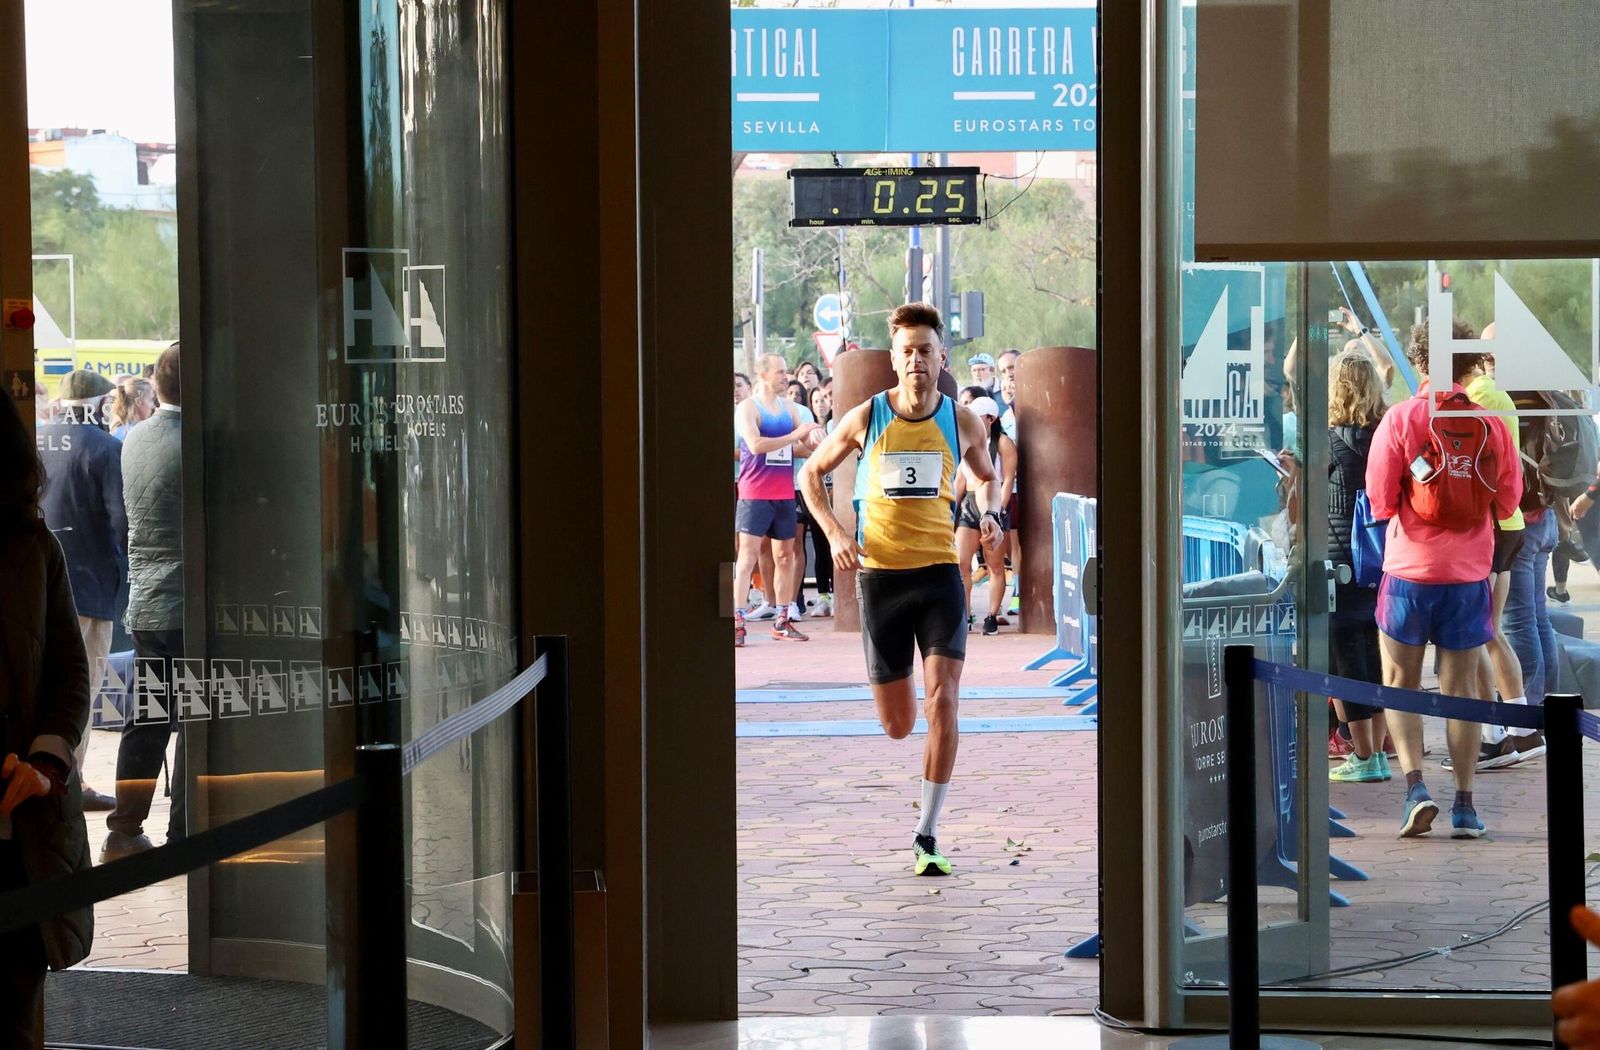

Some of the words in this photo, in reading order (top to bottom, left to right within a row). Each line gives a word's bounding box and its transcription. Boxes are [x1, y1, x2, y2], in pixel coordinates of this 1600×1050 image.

[952, 27, 1074, 77] CARRERA
[743, 121, 820, 134] SEVILLA
[954, 119, 1064, 132] EUROSTARS
[873, 180, 965, 214] 0.25
[407, 422, 446, 437] HOTELS
[1194, 423, 1238, 437] 2024
[351, 434, 410, 453] HOELS
[778, 449, 784, 459] 4
[905, 467, 917, 485] 3
